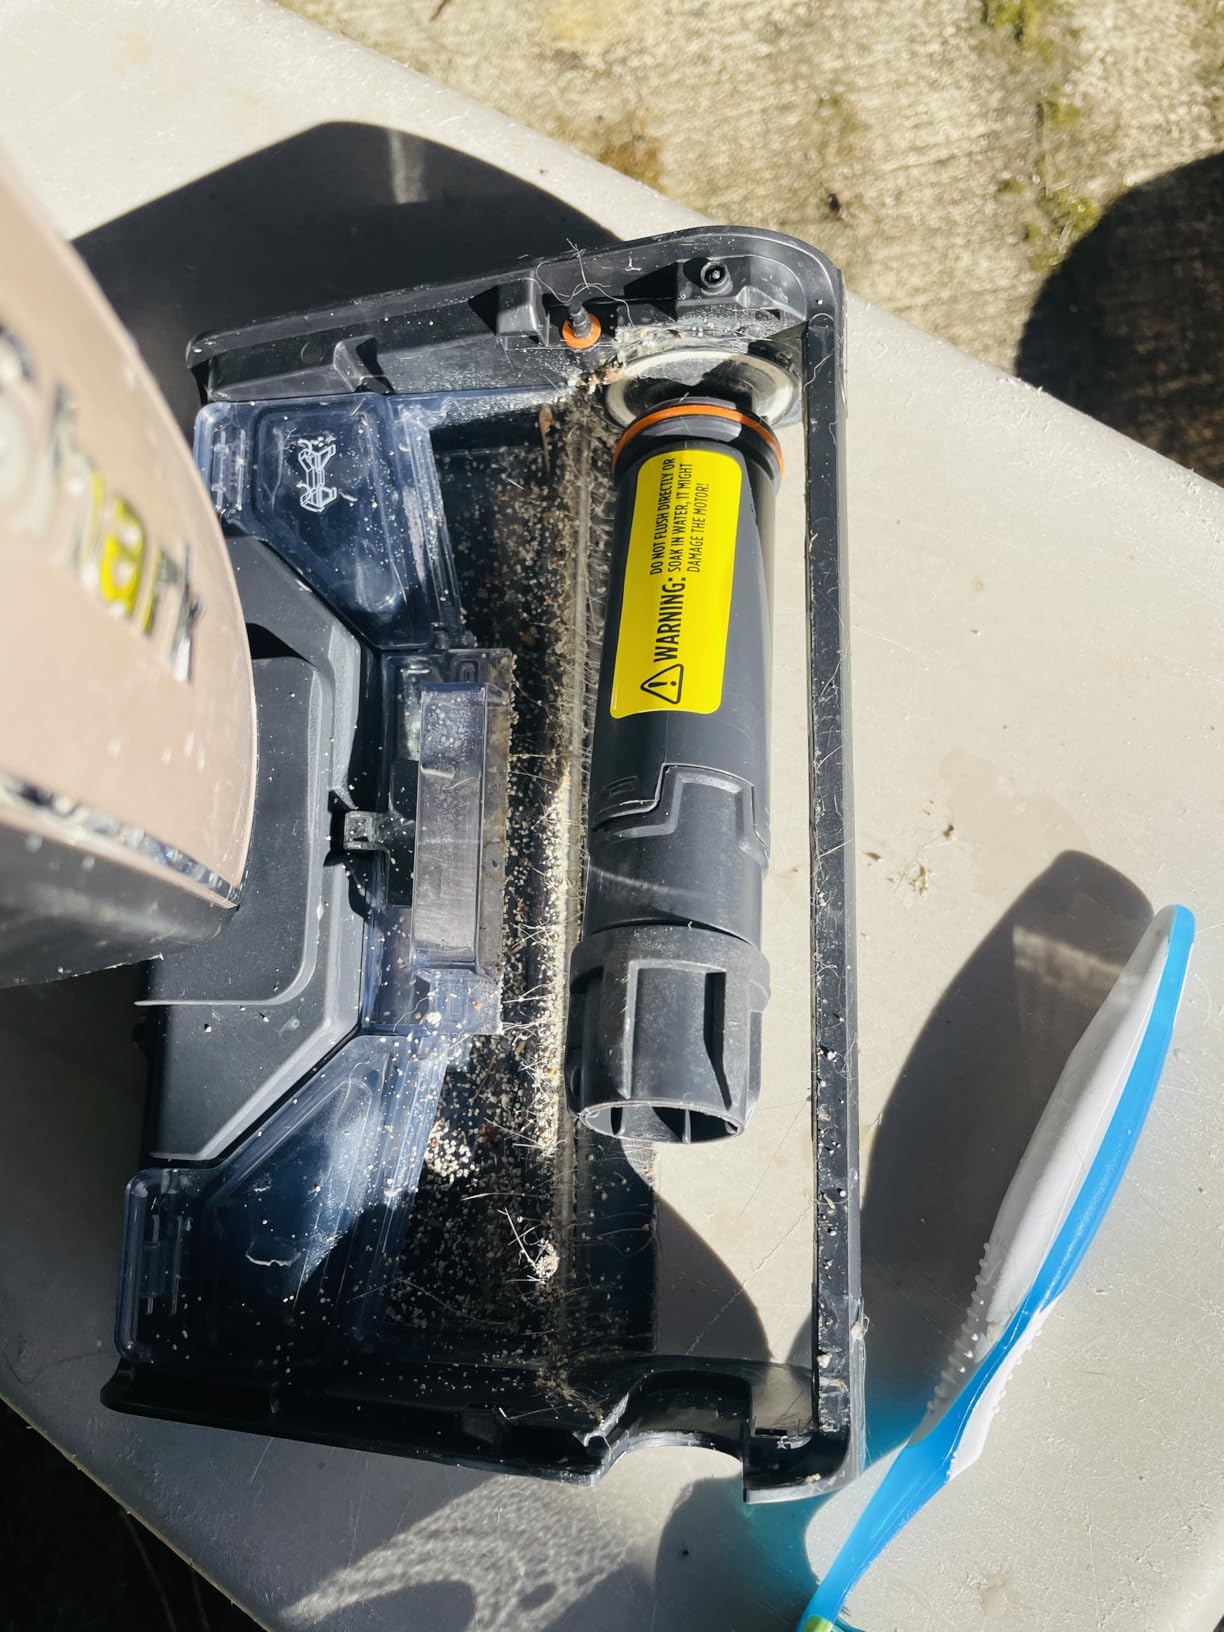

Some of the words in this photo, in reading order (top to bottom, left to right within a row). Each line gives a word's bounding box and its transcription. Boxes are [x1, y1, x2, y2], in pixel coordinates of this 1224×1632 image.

[662, 458, 676, 470] OR
[677, 463, 692, 491] MIGHT
[658, 473, 673, 511] DIRECTLY
[693, 483, 709, 515] MOTOR!
[654, 513, 668, 540] FLUSH
[672, 501, 691, 535] WATER,
[691, 516, 706, 533] THE
[651, 541, 665, 560] NOT
[671, 536, 685, 546] IN
[687, 536, 704, 573] DAMAGE
[650, 561, 663, 575] DO
[668, 549, 682, 572] SOAK
[653, 577, 686, 663] WARNING:
